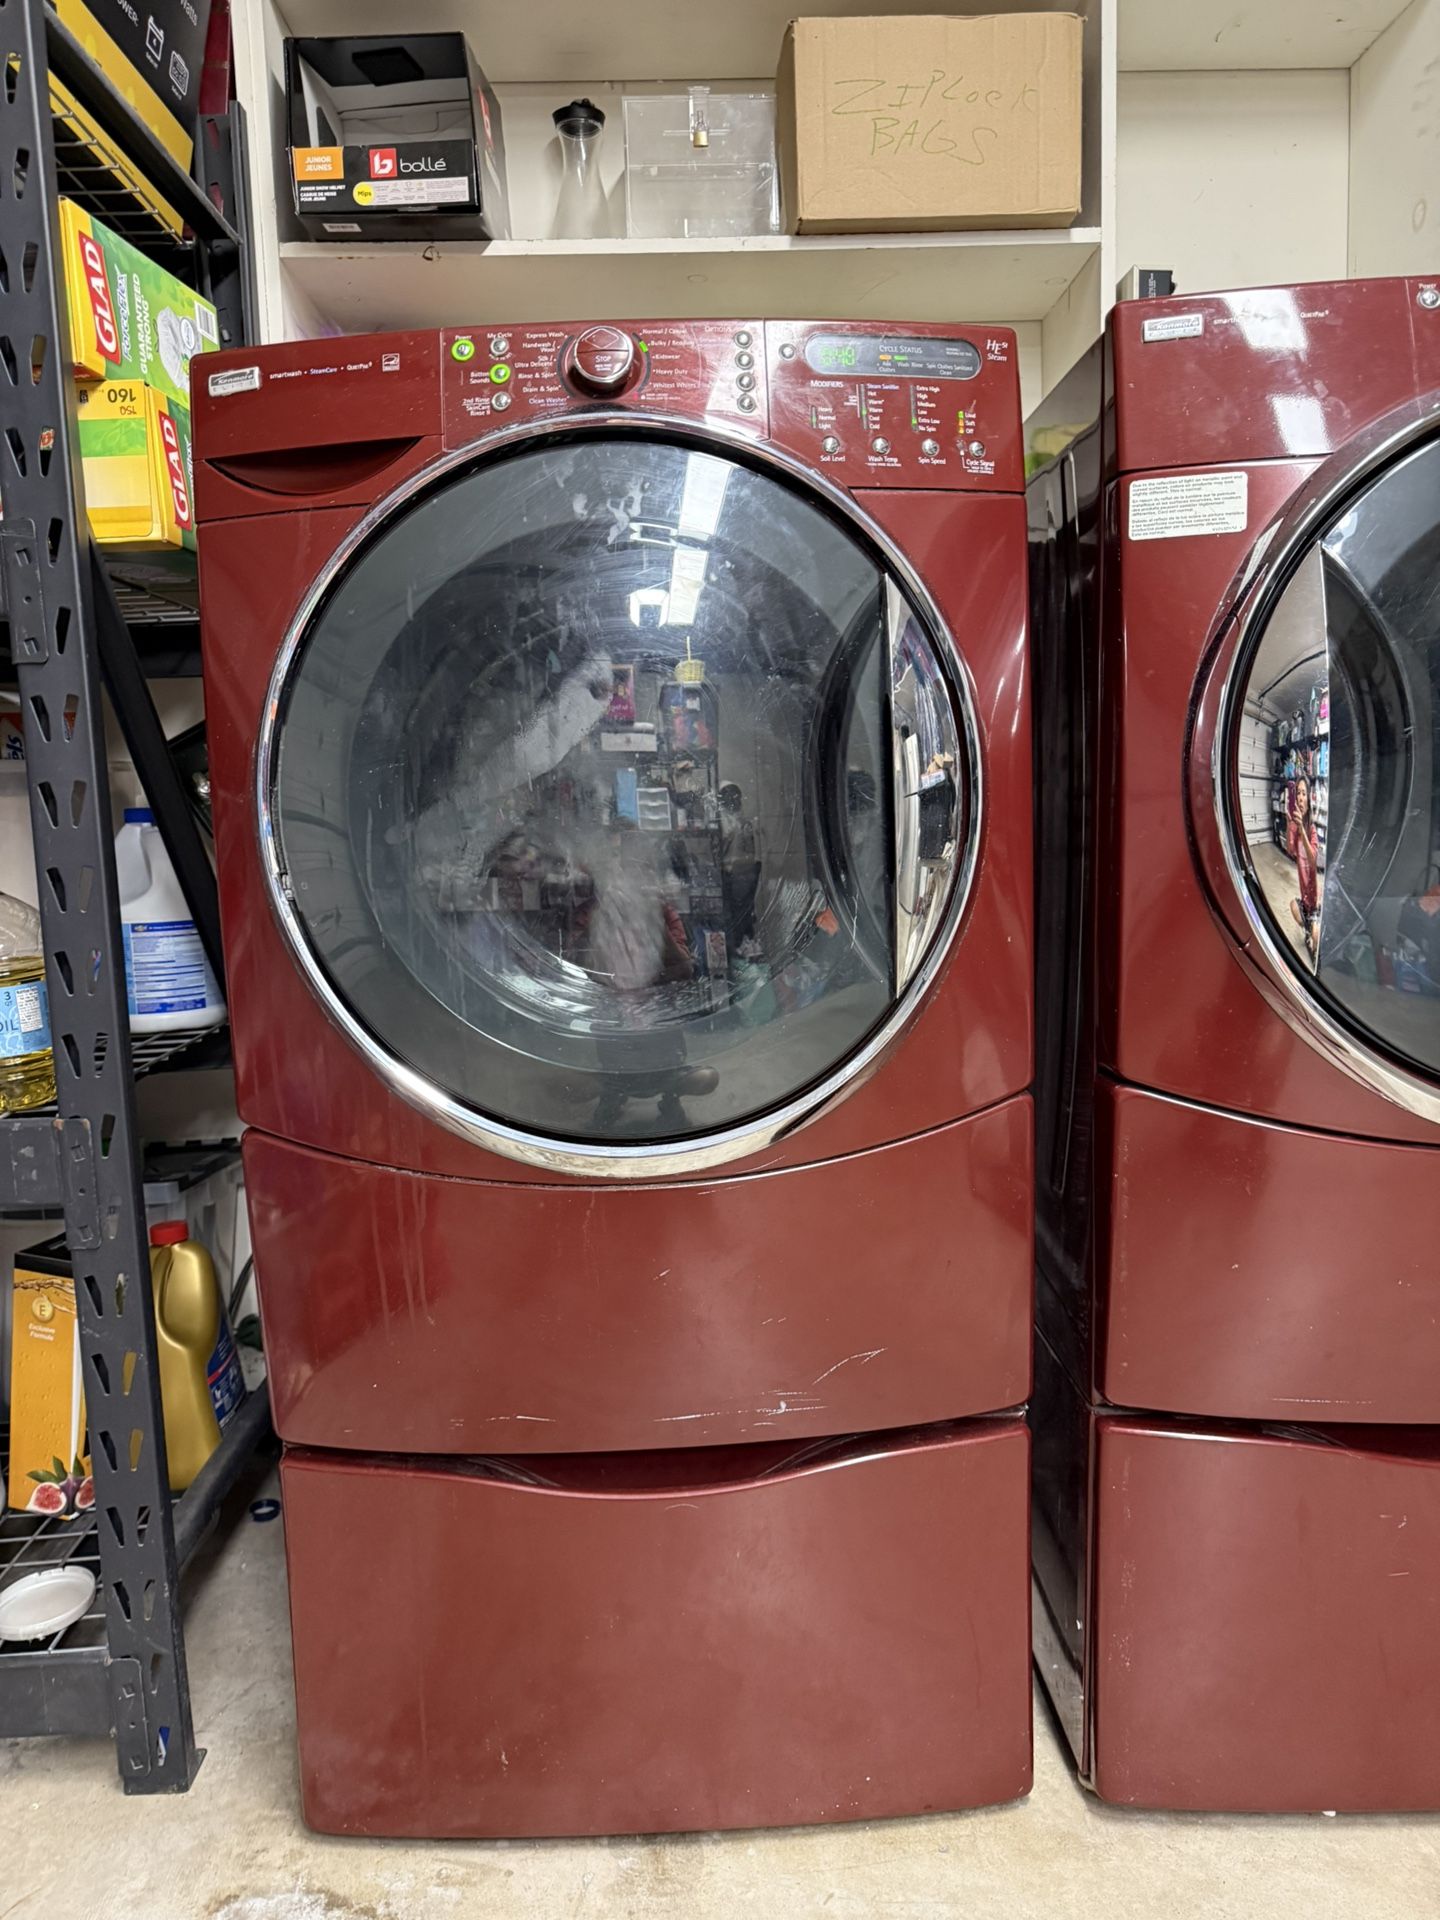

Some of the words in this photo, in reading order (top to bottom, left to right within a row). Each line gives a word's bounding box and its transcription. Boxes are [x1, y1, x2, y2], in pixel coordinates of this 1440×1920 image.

[871, 117, 997, 165] BAGS
[305, 156, 332, 164] JUNIOR
[400, 157, 447, 173] bollé
[305, 164, 332, 172] JEUNES
[85, 240, 116, 353] GLAD
[132, 273, 148, 374] GUARANTEED
[987, 352, 1008, 362] Steam
[214, 371, 254, 385] Kenmore
[107, 388, 137, 403] 160
[884, 456, 898, 464] Temp
[163, 419, 189, 522] GLAD
[4, 991, 11, 1001] 3
